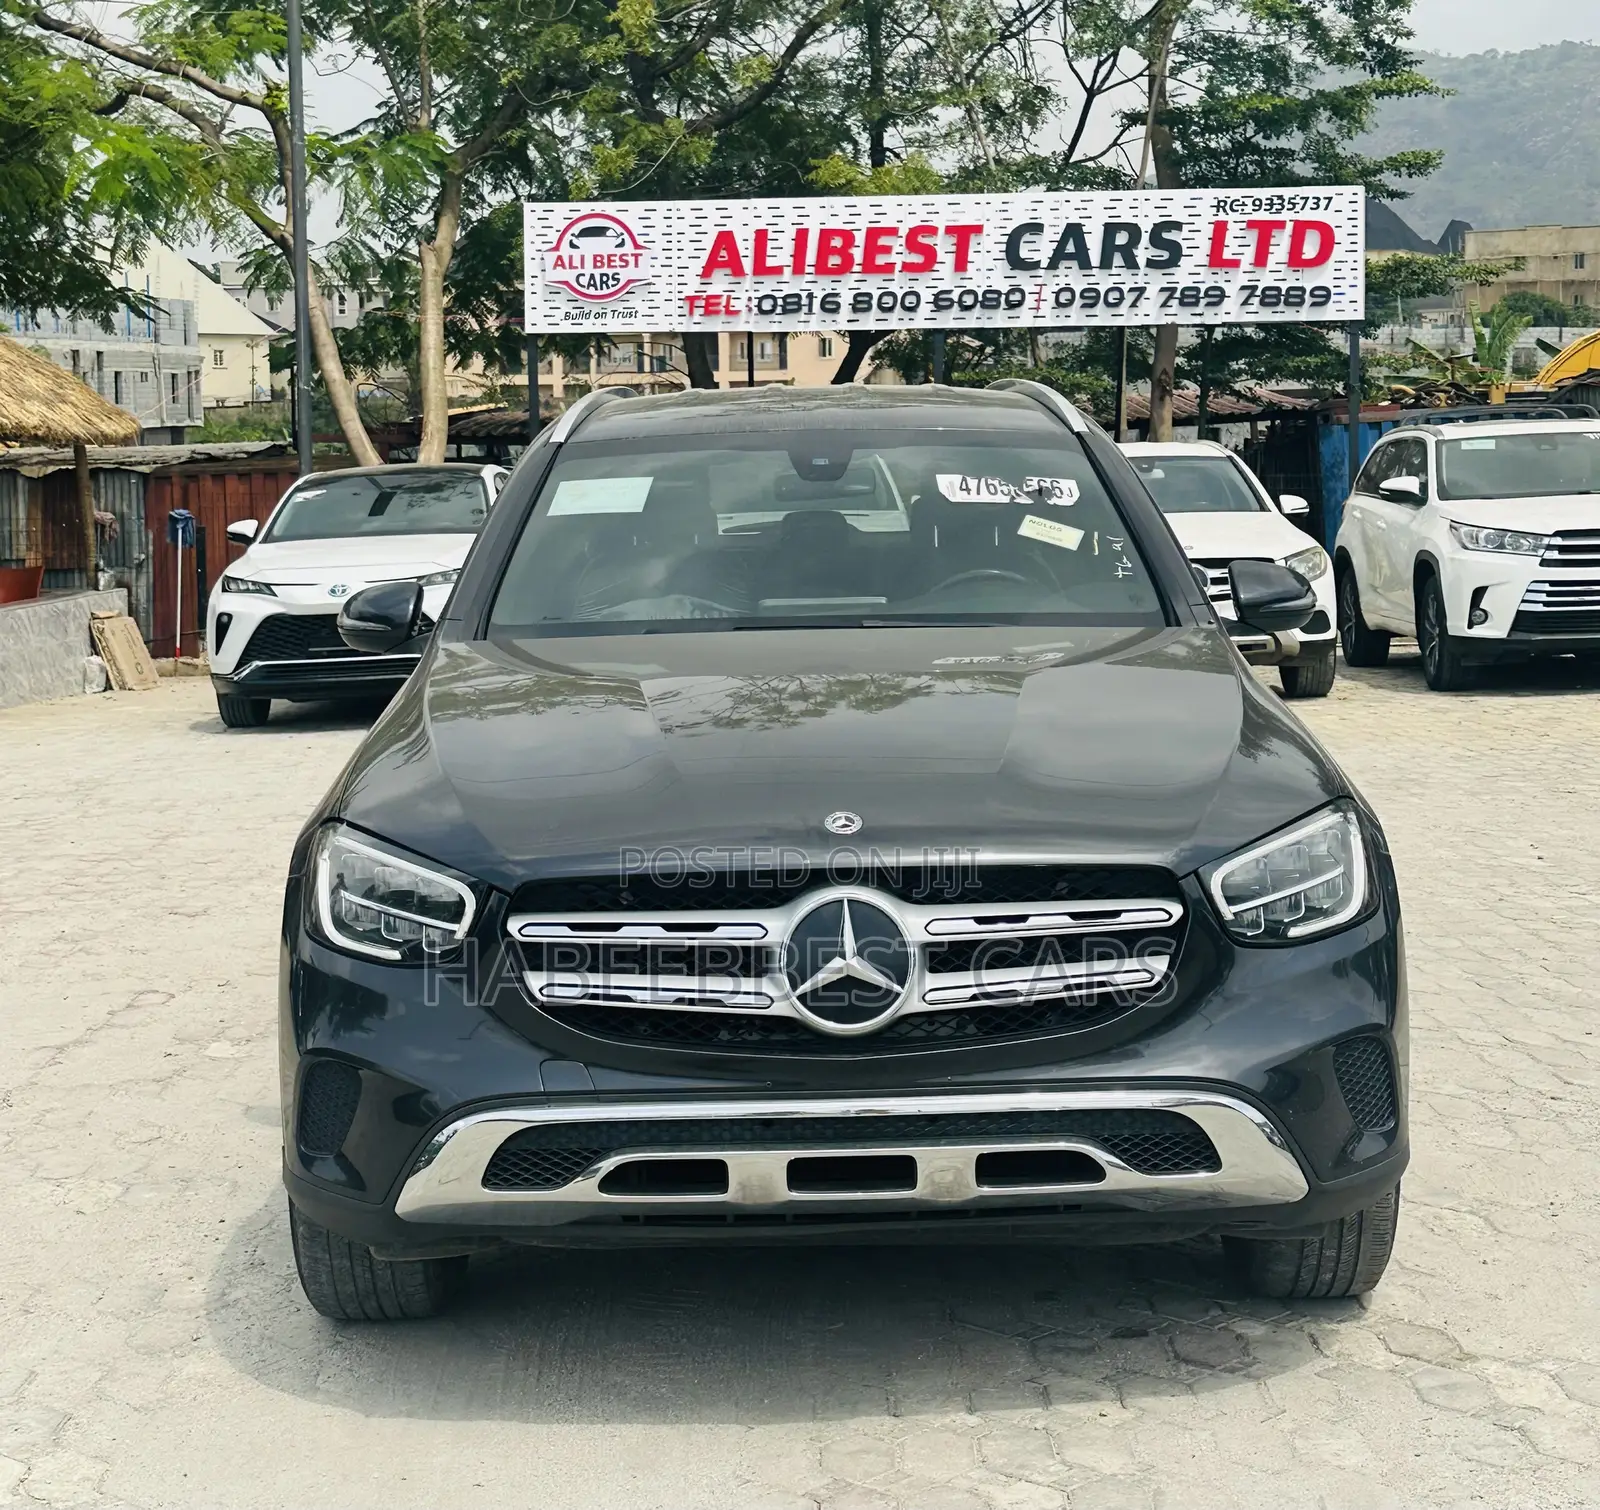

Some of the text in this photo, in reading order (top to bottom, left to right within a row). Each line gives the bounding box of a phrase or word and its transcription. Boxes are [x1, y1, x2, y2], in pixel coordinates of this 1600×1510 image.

[1252, 196, 1333, 212] 9335737
[700, 219, 1335, 279] ALIBEST CARS LTD
[552, 253, 643, 270] ALI BEST
[575, 272, 621, 291] CARS
[757, 292, 841, 316] 0816
[851, 290, 921, 313] 800
[932, 287, 1026, 312] 6080
[1054, 286, 1147, 309] 0907
[1159, 286, 1227, 308] 789
[1240, 285, 1332, 307] 7889
[564, 309, 639, 320] Build on Trust
